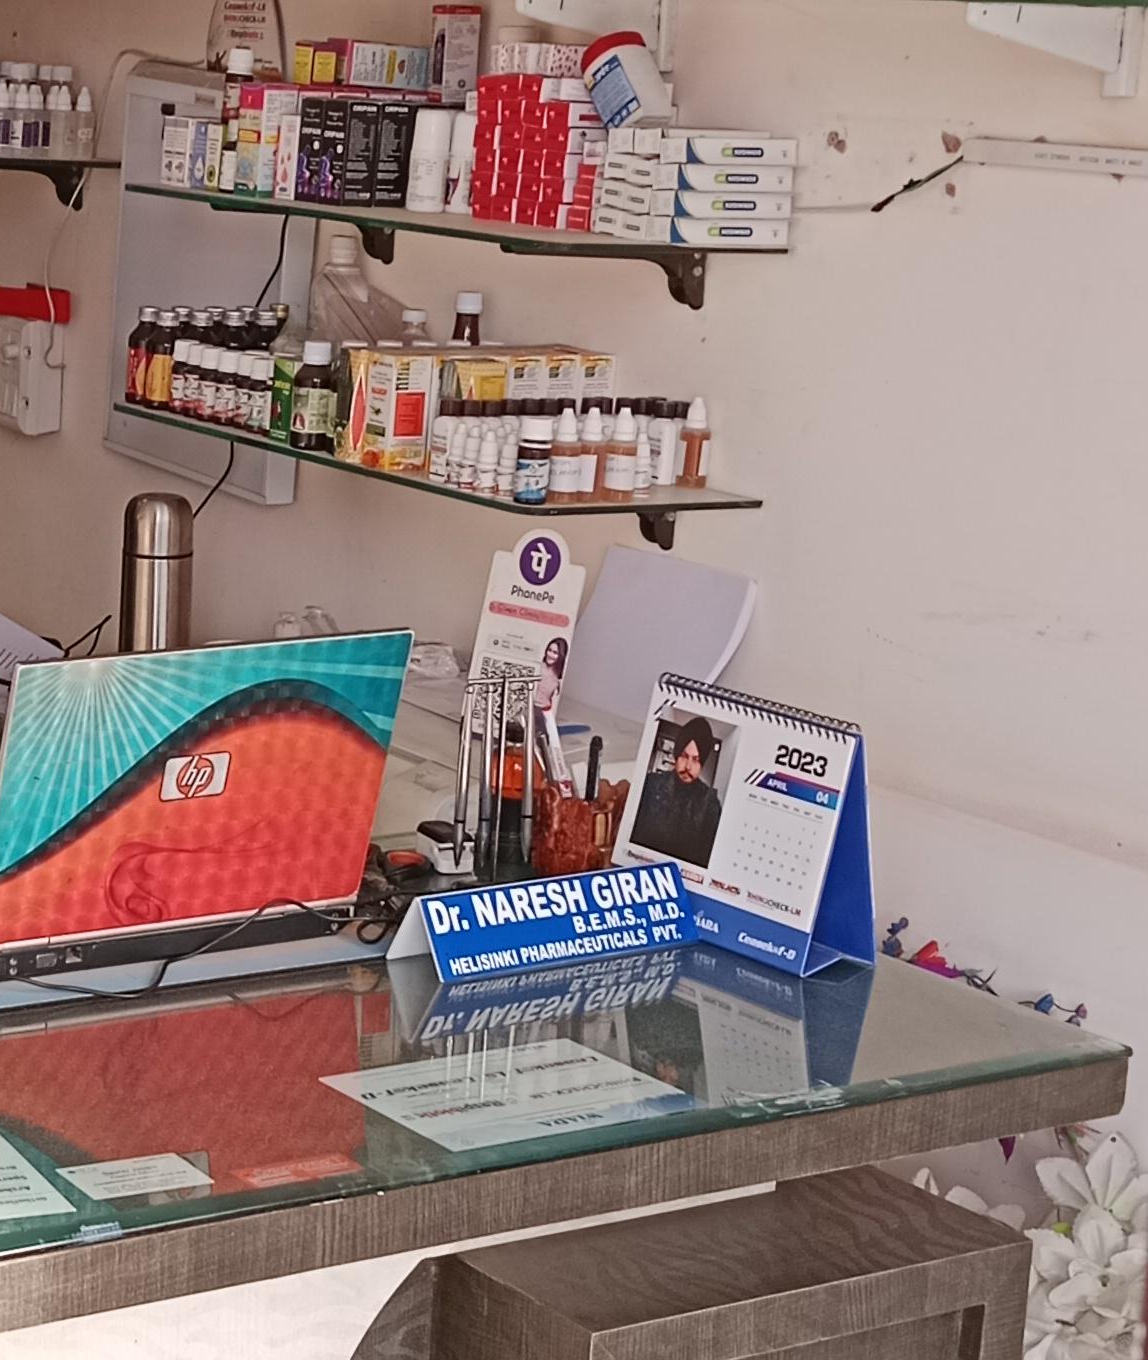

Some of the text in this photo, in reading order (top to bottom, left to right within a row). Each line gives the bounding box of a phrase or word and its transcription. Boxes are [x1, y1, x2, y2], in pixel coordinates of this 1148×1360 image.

[530, 542, 552, 579] पे
[510, 584, 555, 604] PhonePe
[179, 754, 214, 798] hp
[775, 744, 828, 778] 2023
[766, 778, 829, 804] APRIL 04
[427, 900, 469, 935] Dr.
[471, 880, 587, 928] NARESH
[590, 865, 679, 910] GIRAN
[650, 901, 685, 922] M.D.
[449, 924, 682, 977] HELISINKI PHARMACEUTICALS PVT.
